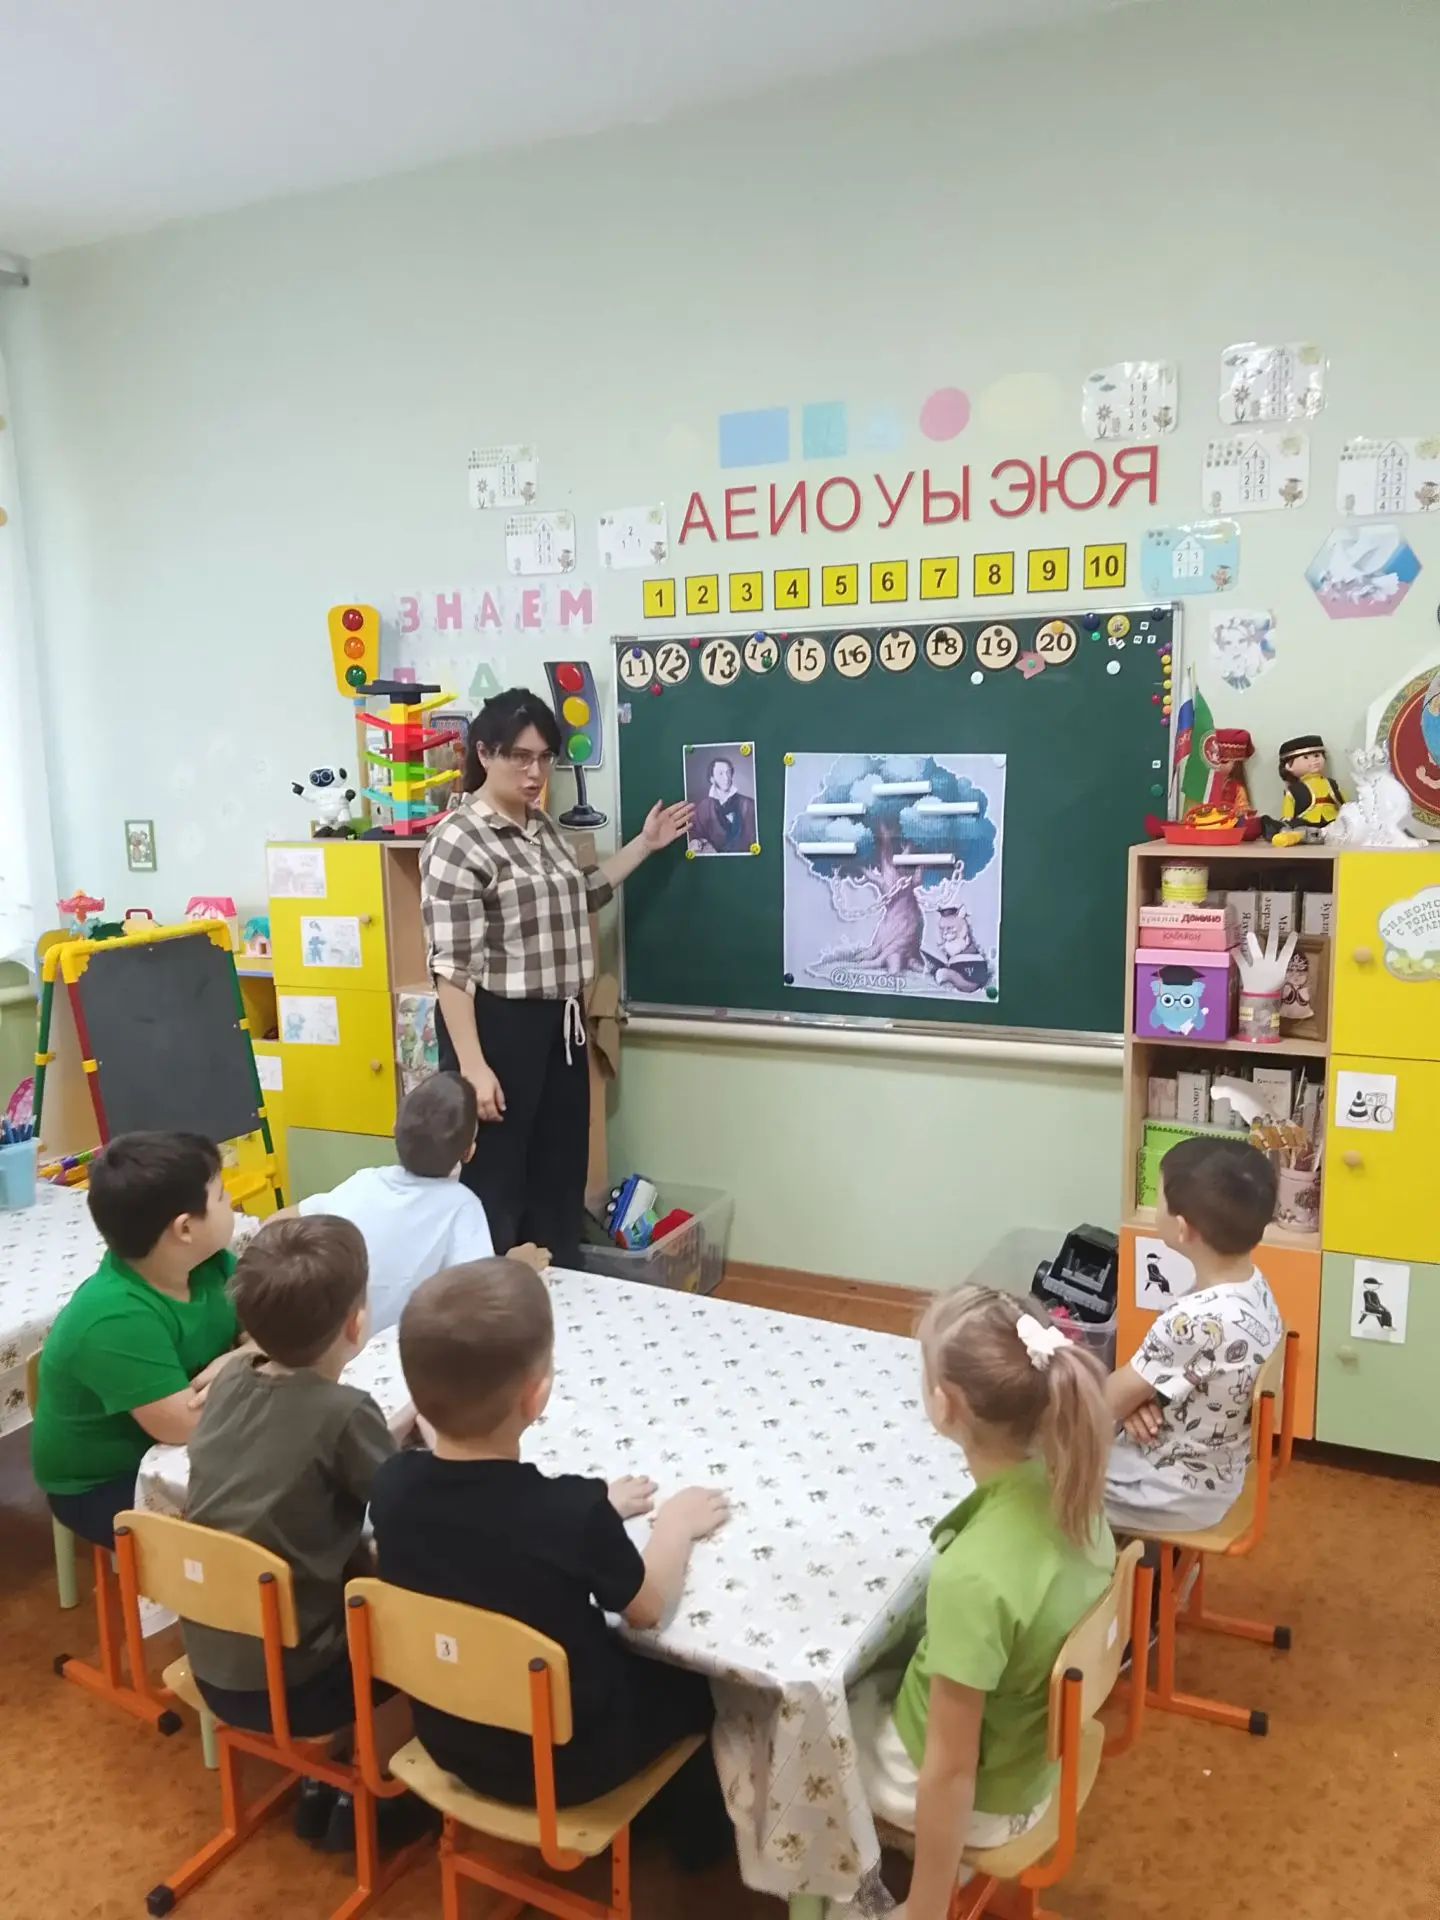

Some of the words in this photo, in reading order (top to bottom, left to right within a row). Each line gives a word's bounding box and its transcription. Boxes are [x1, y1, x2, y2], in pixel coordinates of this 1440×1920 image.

[1244, 475, 1250, 485] 2
[1259, 474, 1265, 484] 2
[1177, 552, 1183, 562] 2
[655, 589, 663, 607] 1
[697, 585, 709, 604] 2
[741, 583, 753, 602] 3
[786, 579, 799, 599] 4
[835, 575, 847, 595] 5
[881, 571, 894, 592] 6
[934, 567, 947, 588] 7
[988, 563, 1001, 585] 8
[1042, 559, 1056, 581] 9
[1090, 555, 1119, 578] 10
[400, 588, 593, 633] ЗНАЕМ
[625, 658, 649, 677] 11
[659, 647, 687, 680] 12
[705, 647, 737, 679] 13
[794, 647, 817, 671] 15
[838, 644, 866, 667] 16
[884, 640, 910, 661] 17
[931, 637, 957, 656] 18
[981, 636, 1012, 656] 19
[1039, 632, 1072, 652] 20
[830, 967, 906, 992] @yavosp
[440, 1640, 451, 1657] 3
